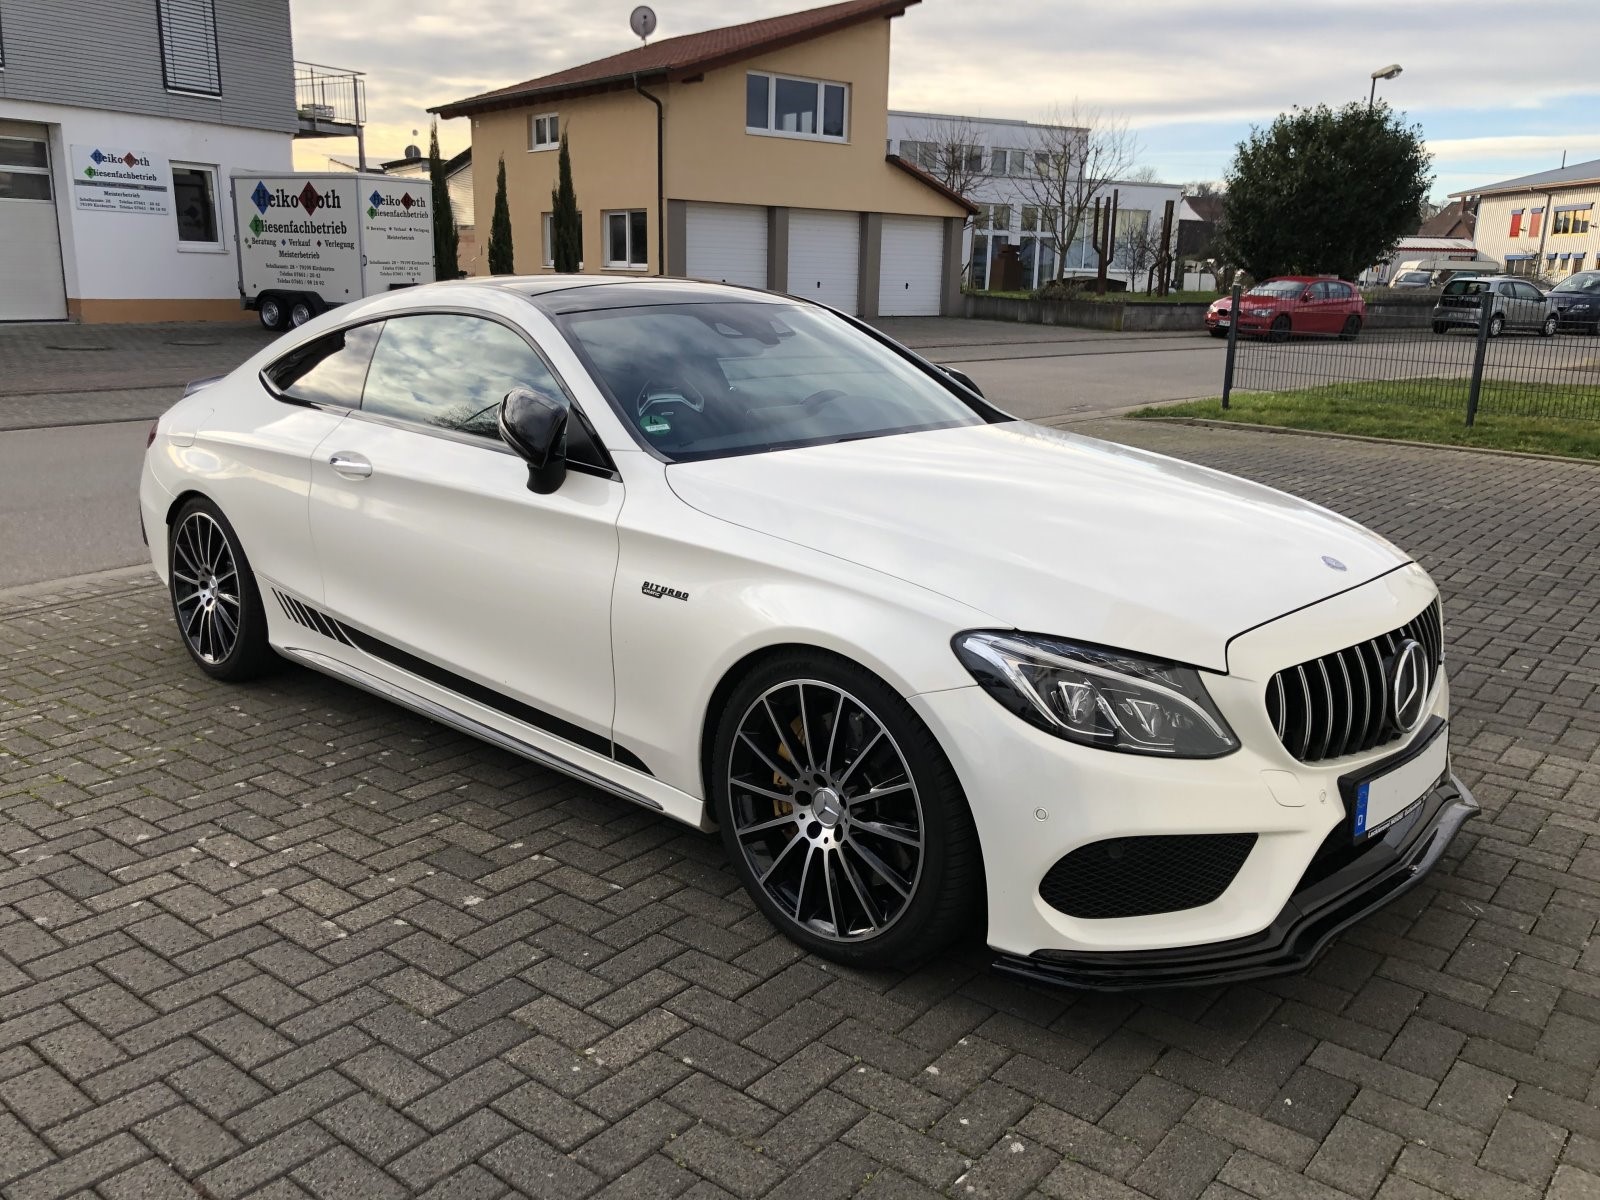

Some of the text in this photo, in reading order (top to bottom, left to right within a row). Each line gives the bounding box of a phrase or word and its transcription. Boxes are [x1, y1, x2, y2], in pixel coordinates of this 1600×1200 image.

[88, 168, 157, 181] Fliesenfachbetrieb
[256, 188, 299, 208] Heiko
[255, 219, 347, 235] Fliesenfachbetrieb
[251, 237, 355, 250] Beratung Verkauf Verlegung
[278, 250, 320, 259] Meisterbetrieb
[643, 581, 690, 600] BITURBO
